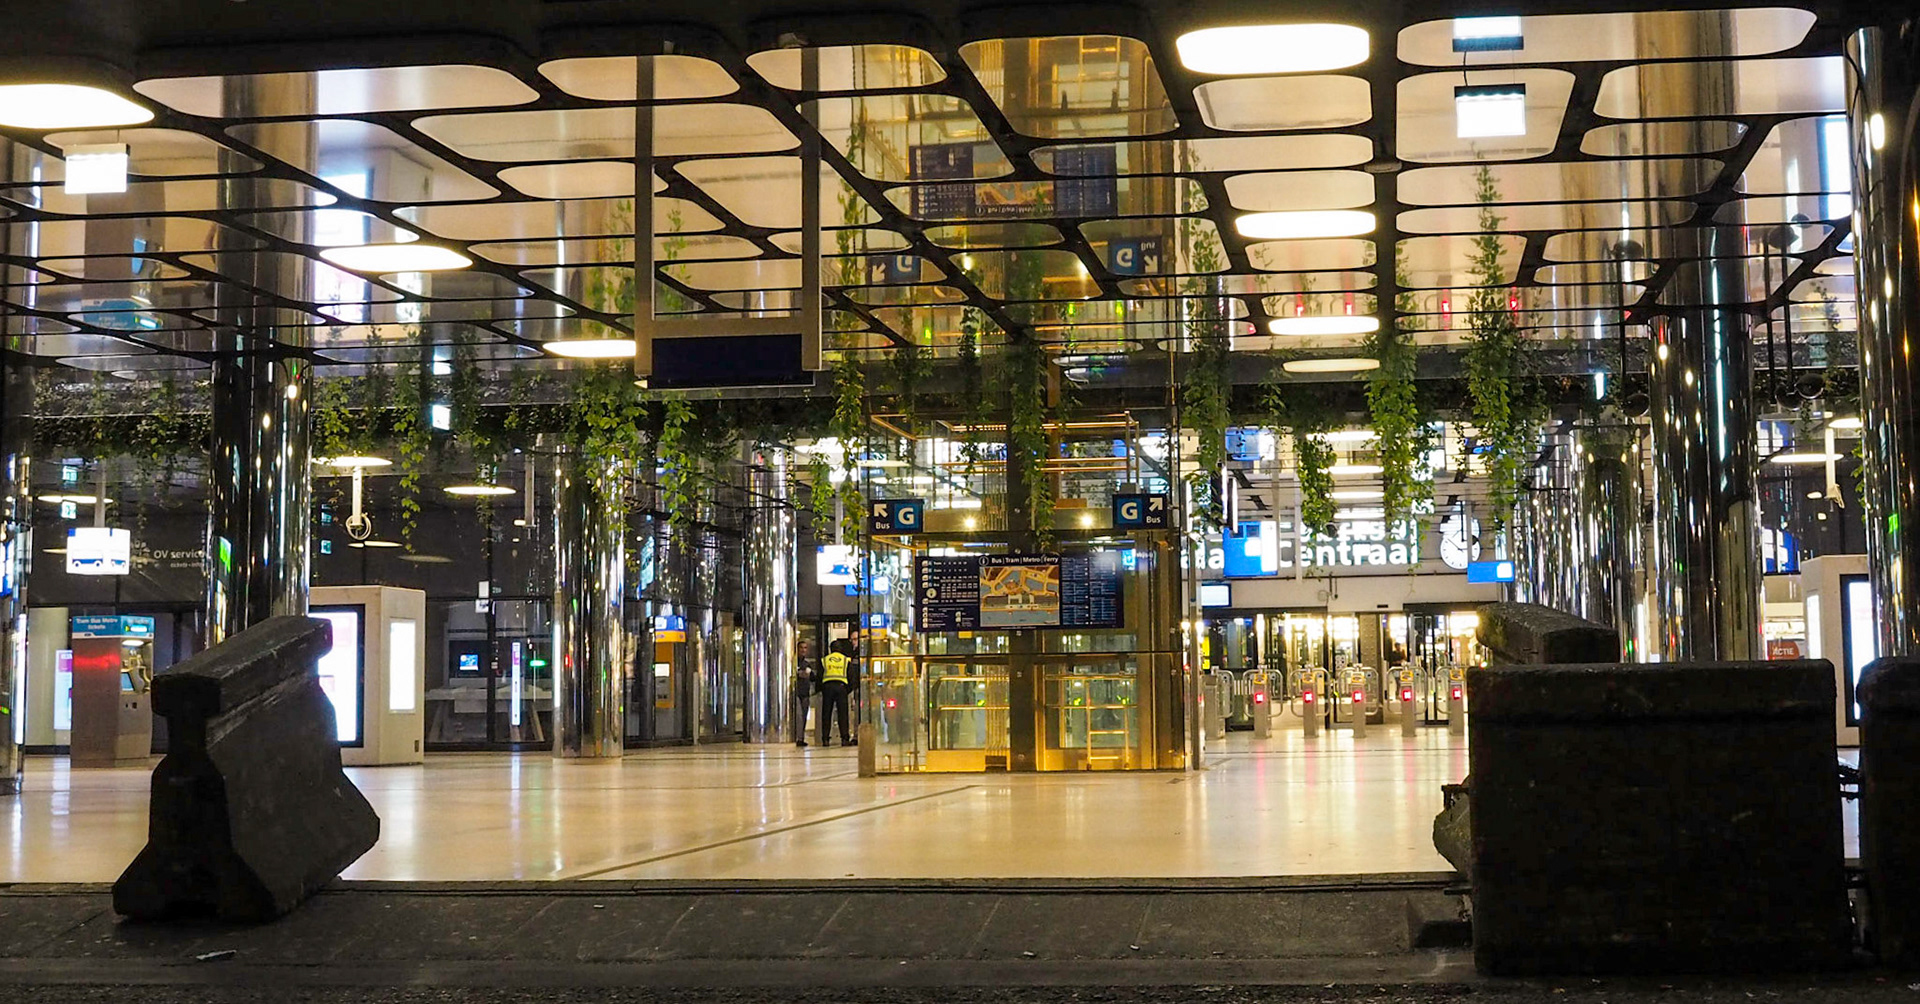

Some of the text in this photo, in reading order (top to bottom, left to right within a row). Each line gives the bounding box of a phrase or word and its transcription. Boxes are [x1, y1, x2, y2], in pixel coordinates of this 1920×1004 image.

[898, 507, 914, 524] G
[1121, 502, 1138, 520] G
[1146, 516, 1161, 524] Bus
[876, 522, 890, 530] Bus
[154, 550, 168, 559] OV
